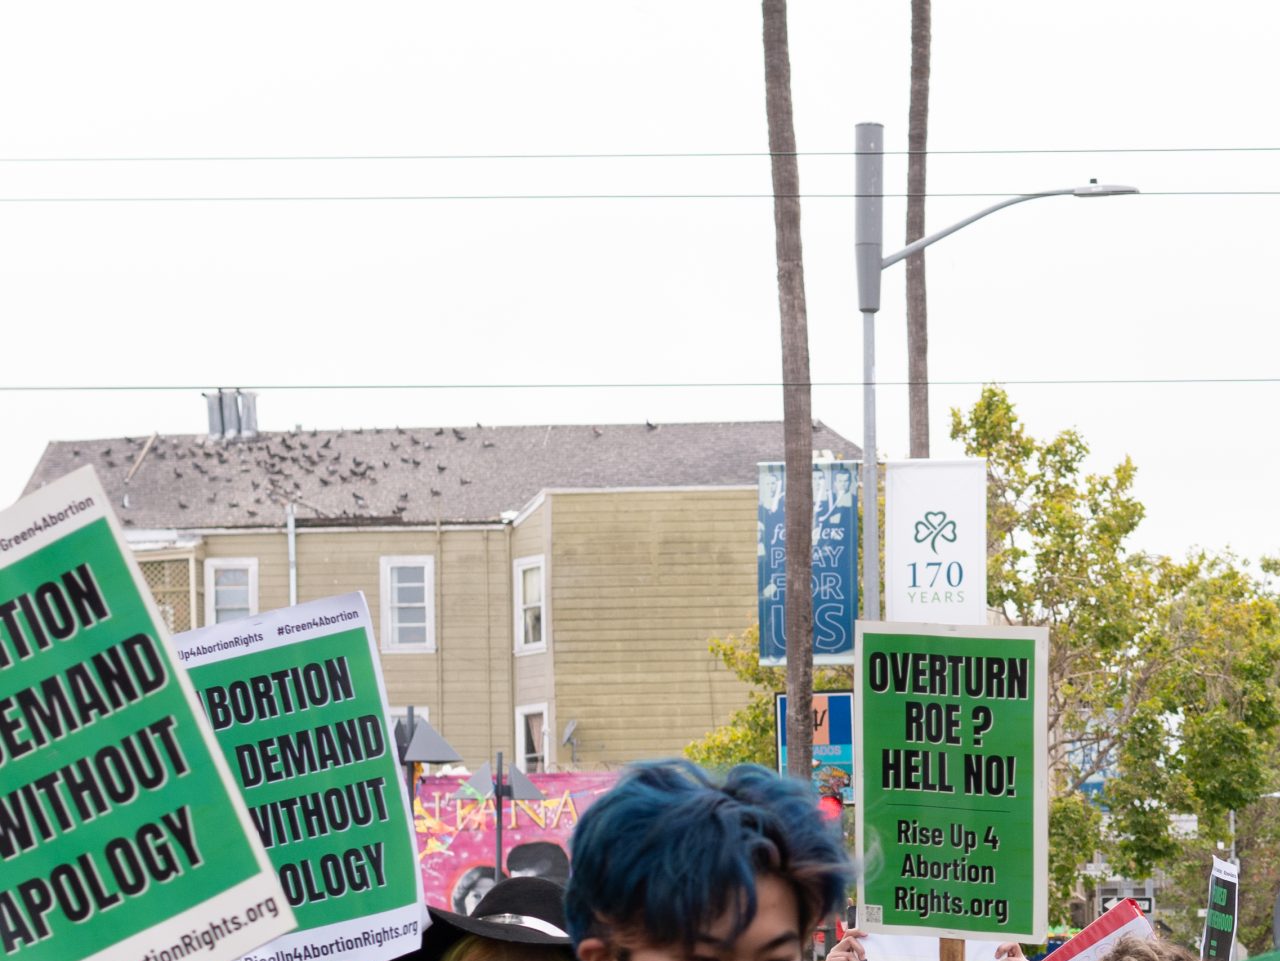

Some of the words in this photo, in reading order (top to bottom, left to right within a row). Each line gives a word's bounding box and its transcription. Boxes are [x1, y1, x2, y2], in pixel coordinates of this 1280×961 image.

[771, 546, 845, 569] PAY
[907, 561, 963, 588] 170
[908, 590, 965, 604] YEARS
[277, 609, 359, 636] #Green4Abortion
[869, 651, 1030, 700] OVERTURN
[905, 701, 962, 746] ROE
[235, 714, 385, 789] DEMAND
[882, 748, 955, 793] HELL
[964, 753, 1016, 797] NO!
[897, 819, 944, 847] Rise
[950, 823, 977, 855] Up
[983, 825, 1000, 851] 4
[900, 853, 996, 885] Abortion
[894, 886, 1008, 925] Rights.org
